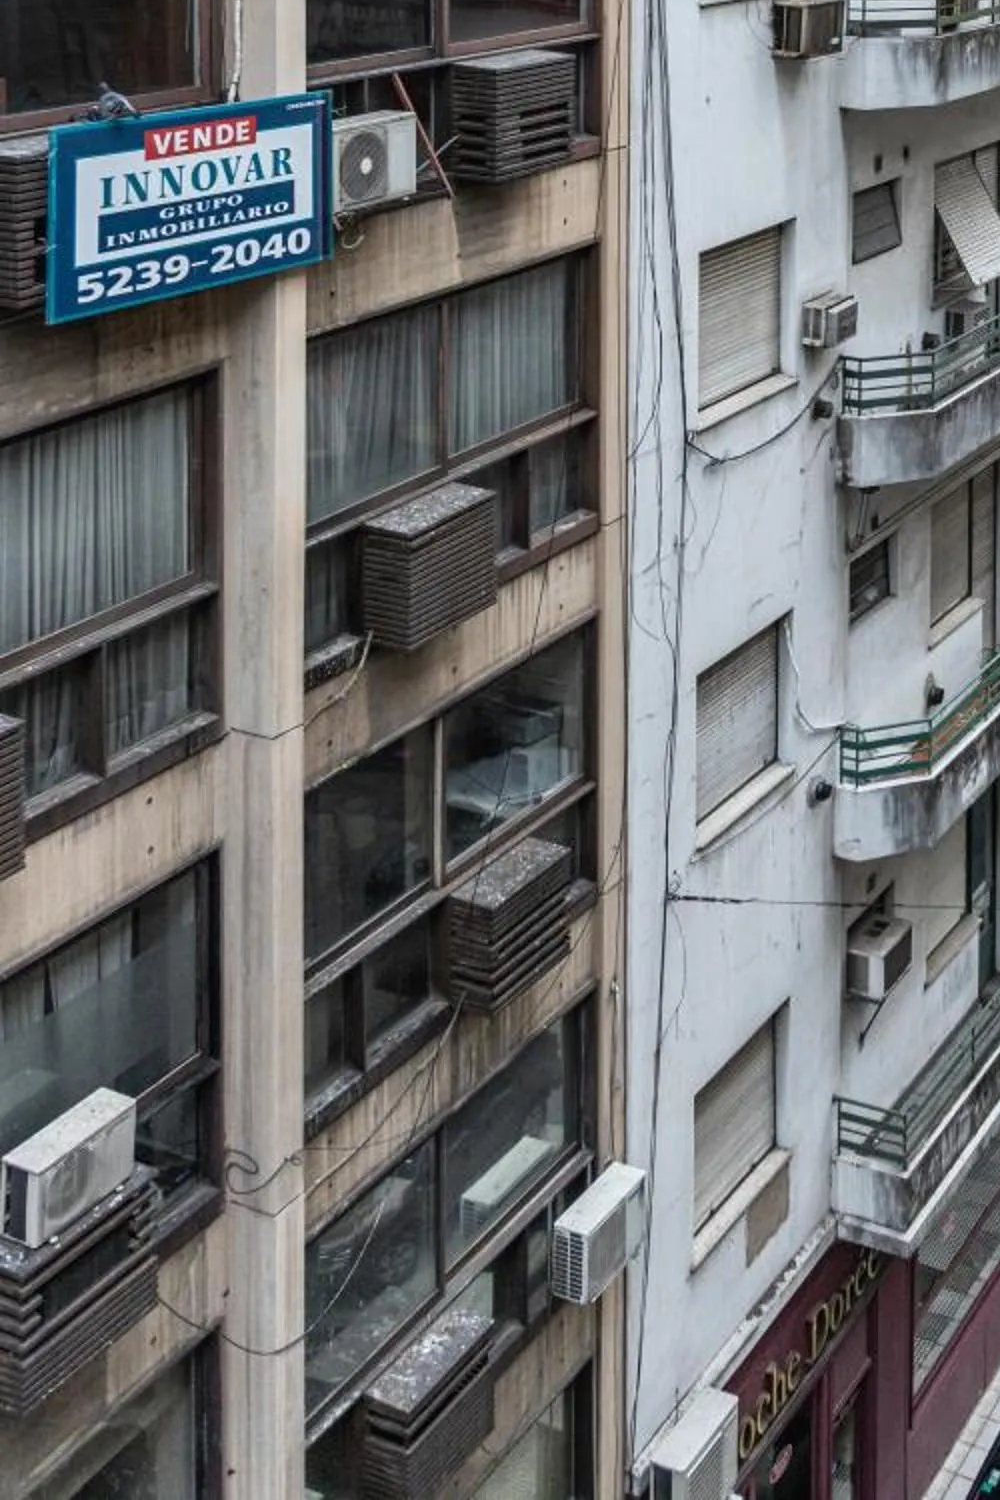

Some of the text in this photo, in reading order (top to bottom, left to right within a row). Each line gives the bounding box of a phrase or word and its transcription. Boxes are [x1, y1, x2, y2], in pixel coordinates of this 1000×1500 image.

[152, 120, 251, 156] VENDE
[99, 147, 294, 210] INNOVAR
[159, 192, 244, 220] GRUPO
[105, 200, 290, 249] INMOBILIARIO
[76, 227, 312, 304] 5239-2040
[739, 1349, 802, 1460] oche
